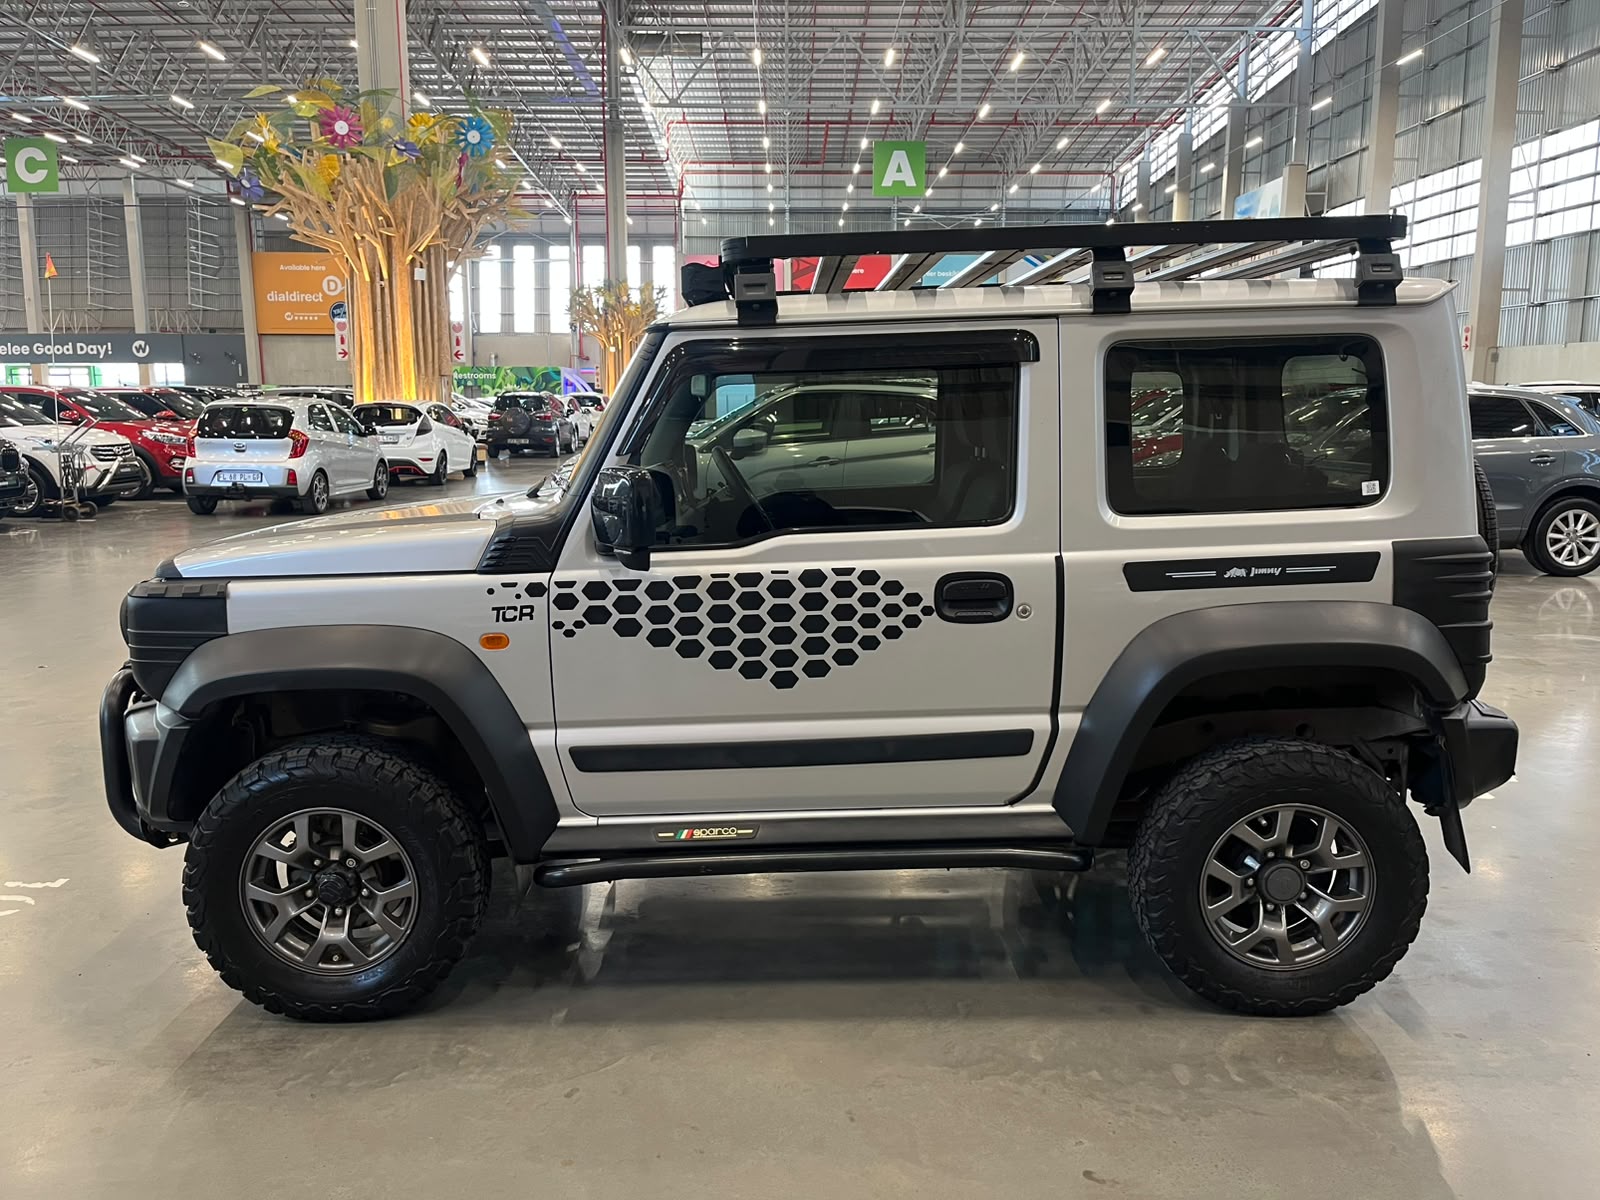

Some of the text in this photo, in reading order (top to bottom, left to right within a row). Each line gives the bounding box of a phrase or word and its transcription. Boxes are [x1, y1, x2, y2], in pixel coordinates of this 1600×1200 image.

[15, 146, 48, 184] C
[881, 150, 917, 187] A
[266, 291, 324, 302] dialdirect
[33, 342, 74, 355] Good
[76, 342, 113, 359] Day!
[491, 604, 535, 623] TCR
[693, 827, 737, 837] sparco
